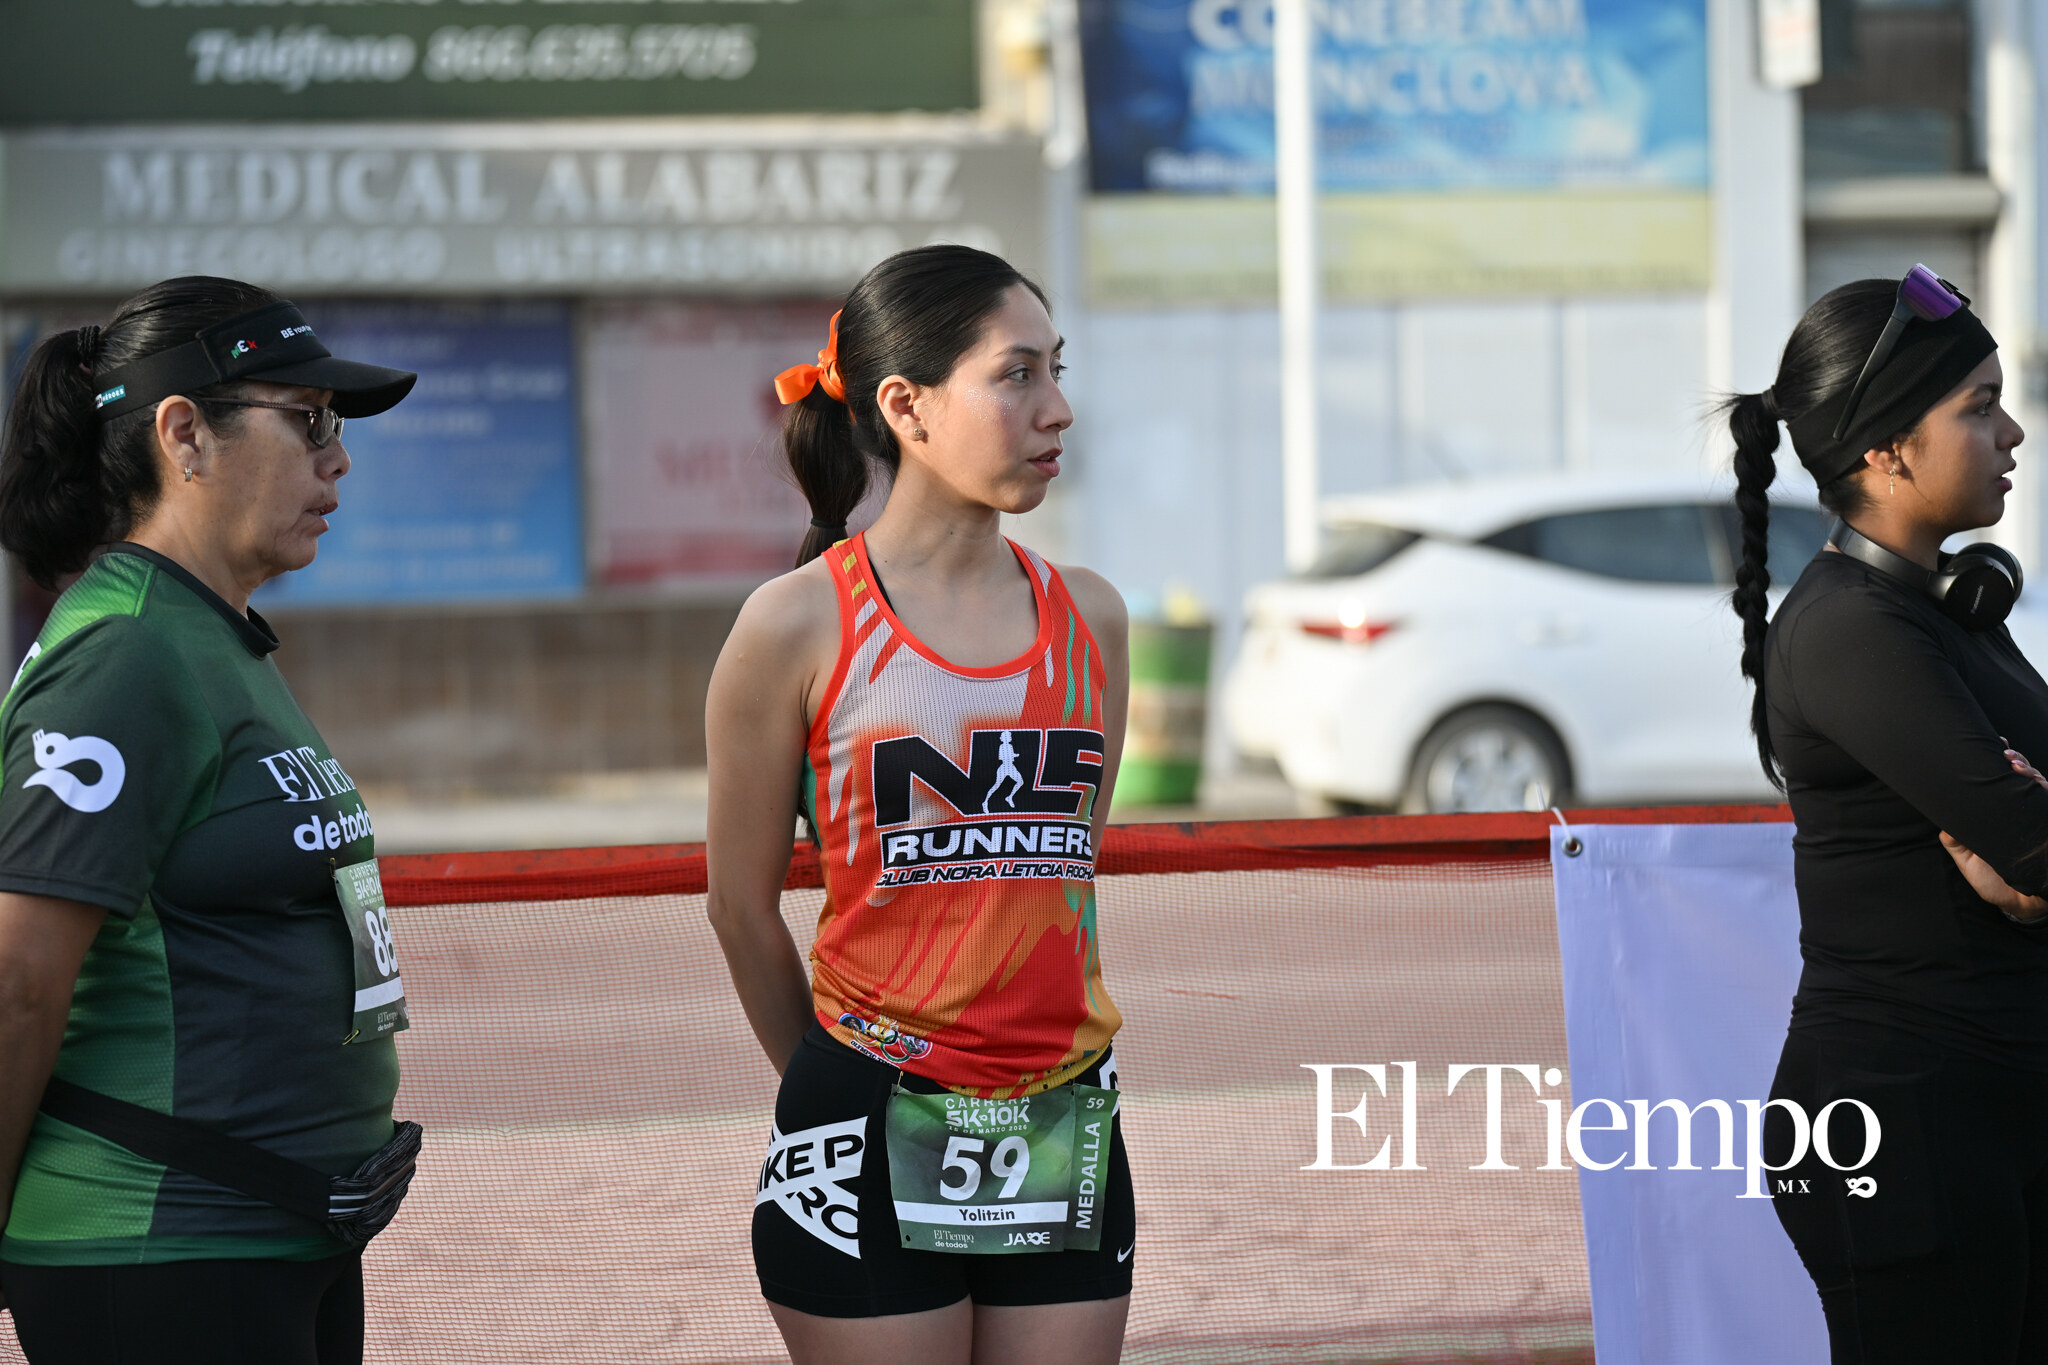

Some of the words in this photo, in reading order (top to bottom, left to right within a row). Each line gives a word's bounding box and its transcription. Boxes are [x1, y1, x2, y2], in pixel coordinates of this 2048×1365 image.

[102, 150, 507, 222] MEDICAL
[534, 150, 964, 222] ALABARIZ
[280, 327, 295, 339] BE
[258, 749, 326, 802] El
[293, 815, 342, 851] de
[875, 867, 931, 888] CLUB
[931, 862, 998, 883] NORA
[999, 861, 1064, 880] LETICIA
[1086, 1097, 1105, 1109] 59
[756, 1141, 815, 1197] IKE
[939, 1135, 1030, 1201] 59
[1075, 1121, 1101, 1230] MEDALLA
[785, 1185, 859, 1241] RO
[933, 1229, 943, 1240] El
[959, 1208, 1016, 1222] Yolitzin
